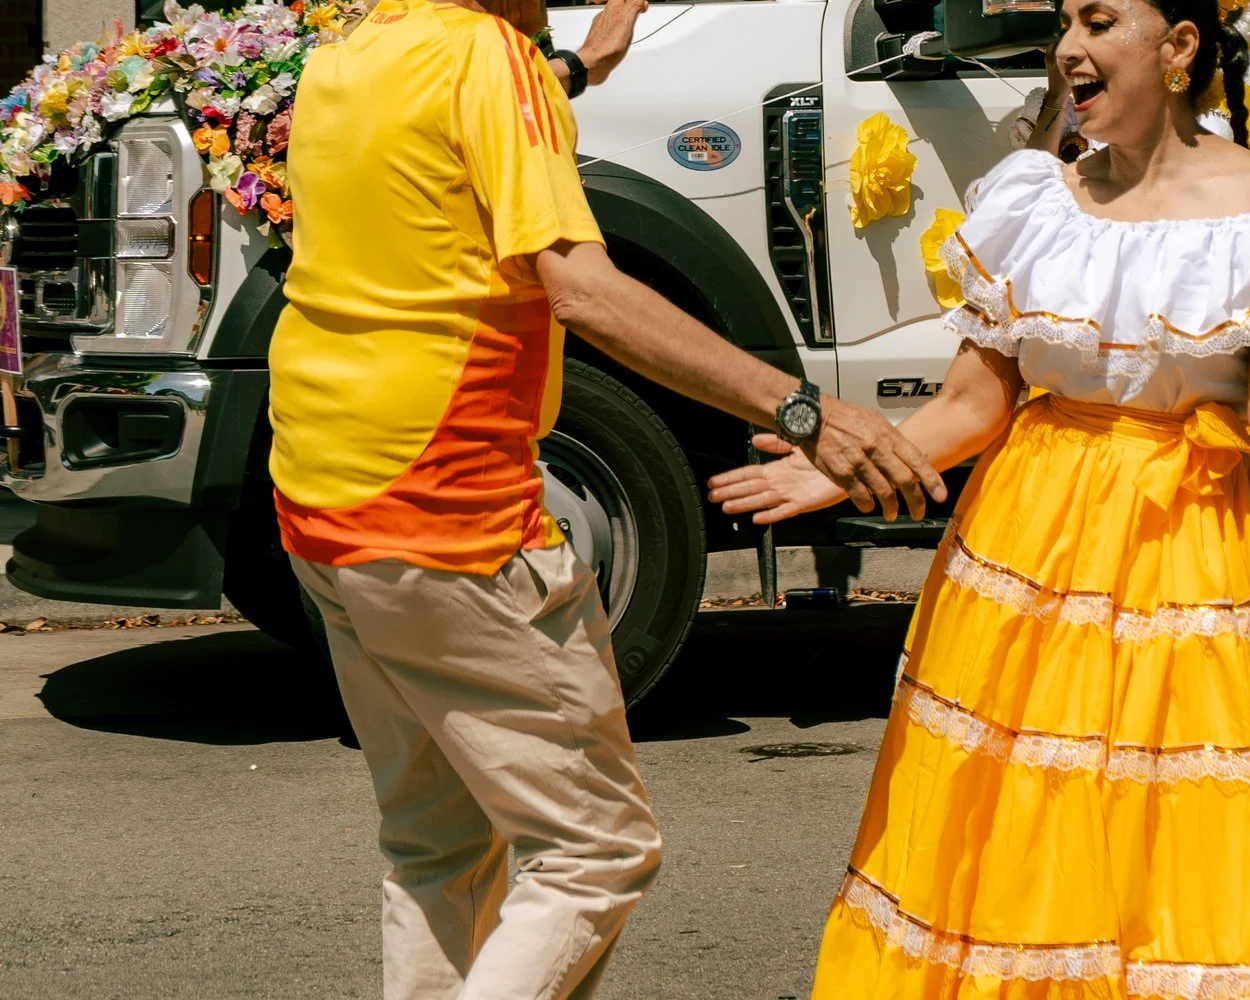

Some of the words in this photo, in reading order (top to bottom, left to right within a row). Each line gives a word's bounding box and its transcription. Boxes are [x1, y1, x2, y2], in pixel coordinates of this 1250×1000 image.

[790, 96, 818, 106] XLT
[681, 136, 727, 144] CERTIFIED
[677, 144, 708, 152] CLEAN
[711, 144, 731, 152] IDLE
[877, 377, 934, 397] 6.7L
